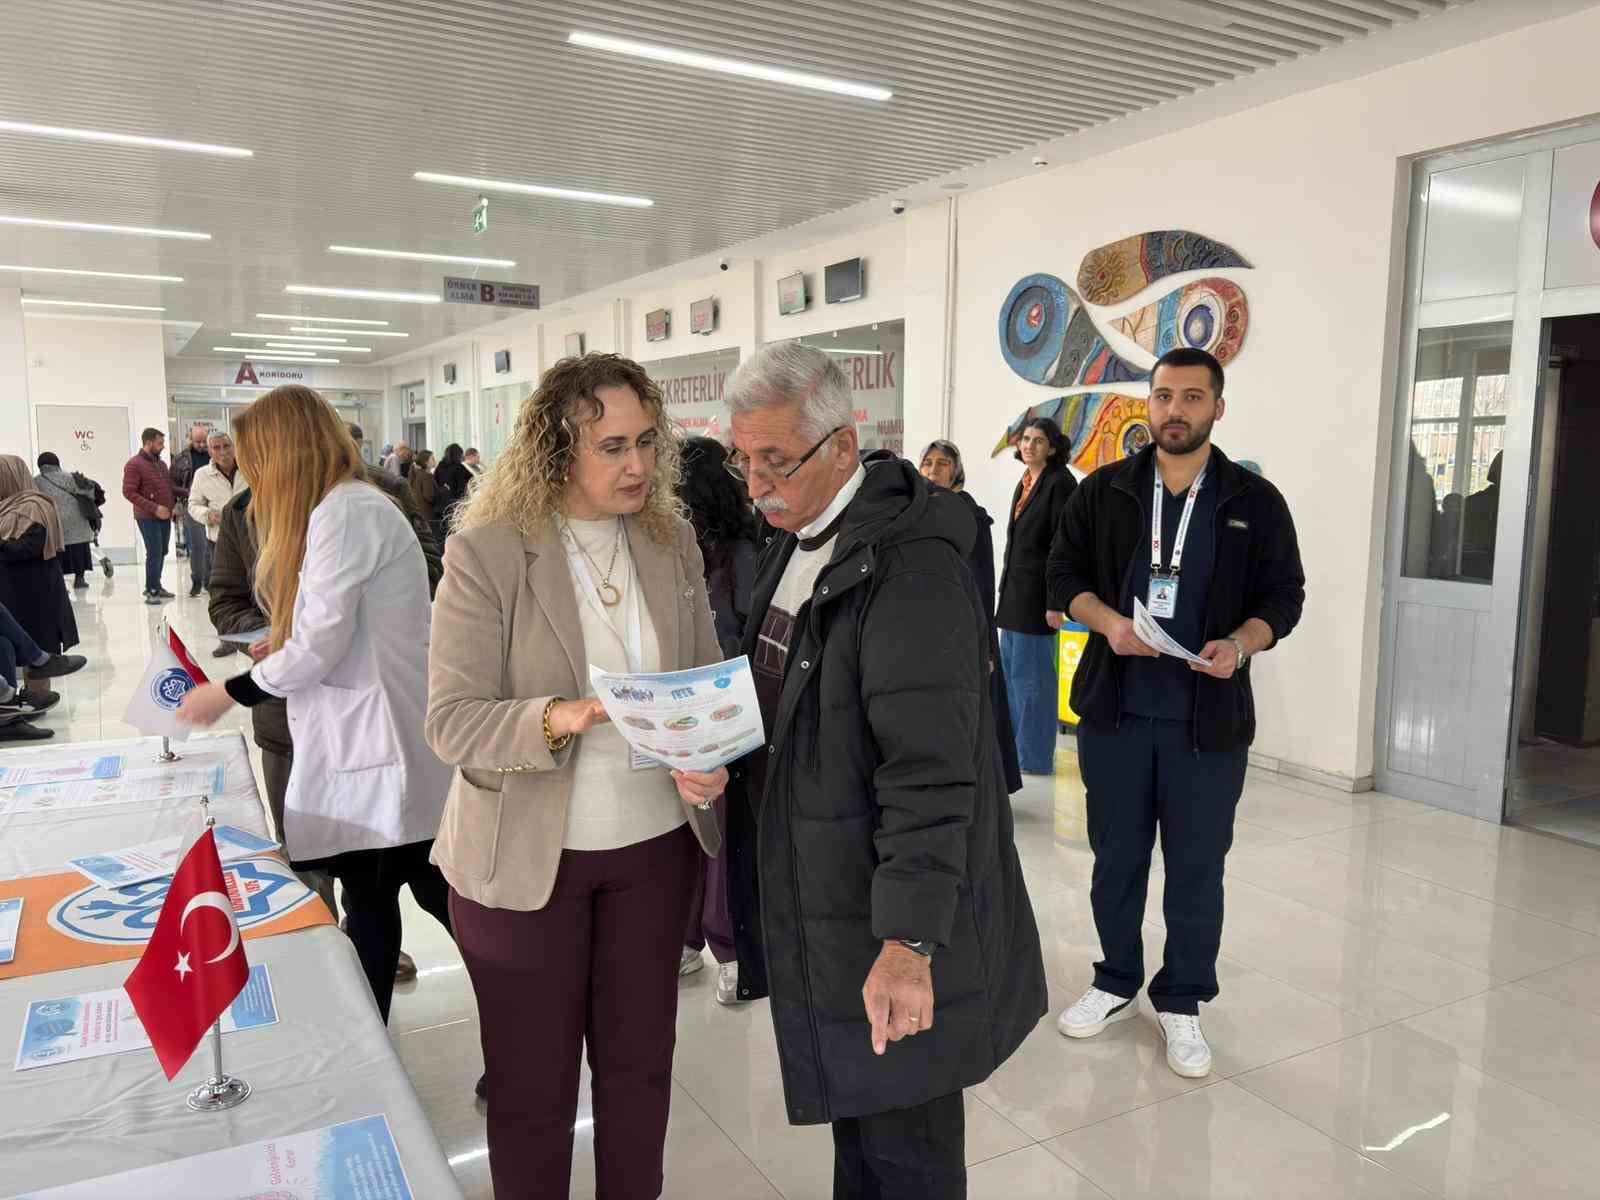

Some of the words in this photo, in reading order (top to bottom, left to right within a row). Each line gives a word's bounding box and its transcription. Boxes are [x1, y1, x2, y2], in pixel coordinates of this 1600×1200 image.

[480, 283, 495, 302] B
[234, 361, 259, 384] A
[656, 368, 726, 404] EKRETERLİK
[74, 430, 95, 439] WC
